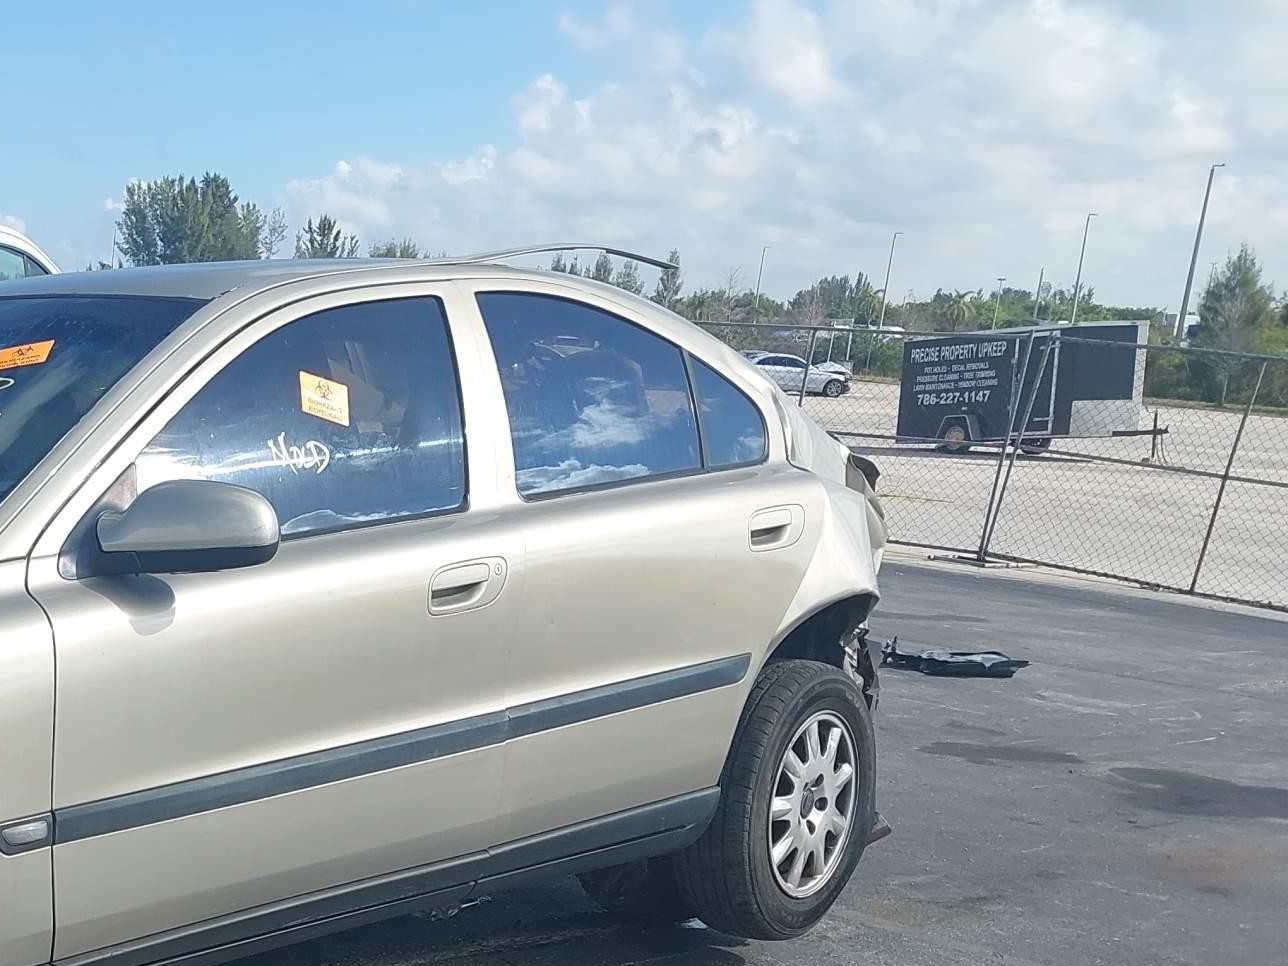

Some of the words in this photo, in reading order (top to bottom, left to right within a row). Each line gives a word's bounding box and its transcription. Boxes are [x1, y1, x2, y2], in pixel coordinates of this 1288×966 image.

[911, 346, 940, 363] PRECISE
[940, 343, 978, 360] PROPERTY
[978, 341, 1007, 357] UPKEEP
[917, 390, 991, 405] 786-227-1147
[266, 431, 331, 475] MOLD
